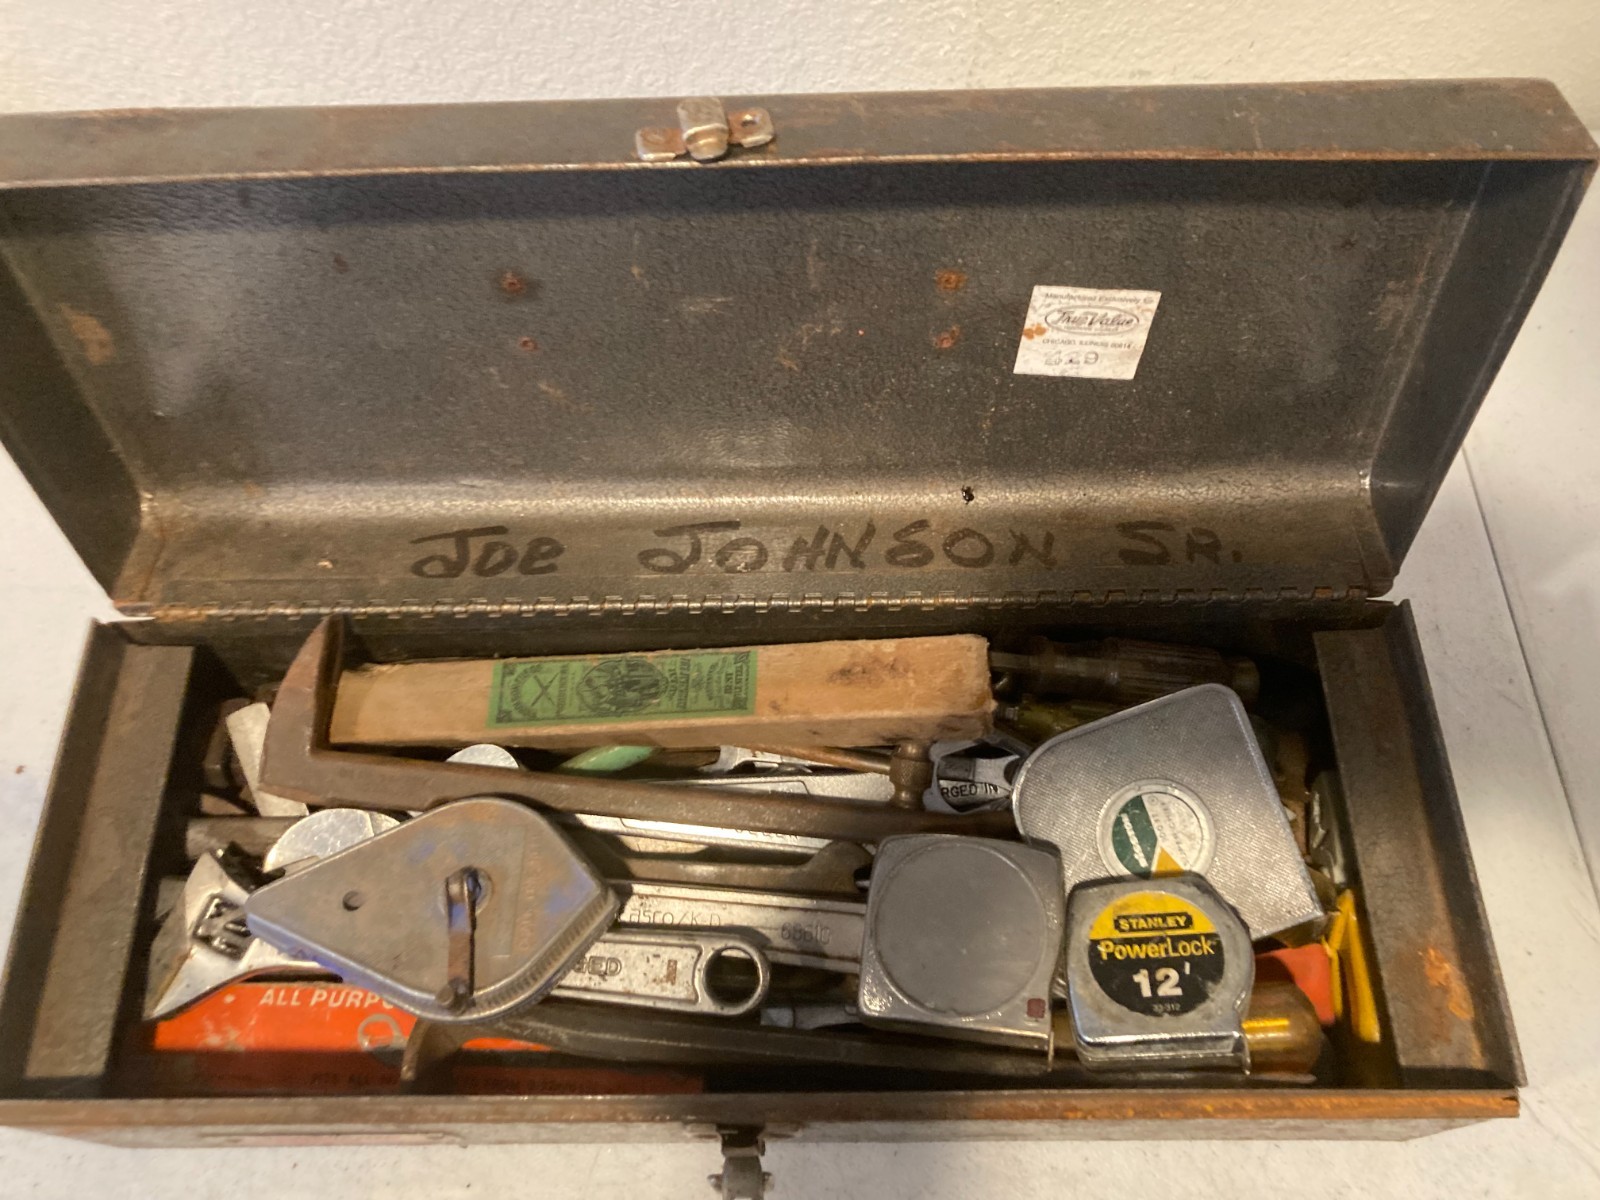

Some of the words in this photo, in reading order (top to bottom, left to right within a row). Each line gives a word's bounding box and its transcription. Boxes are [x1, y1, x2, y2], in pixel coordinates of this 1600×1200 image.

[637, 518, 1058, 574] JOHNSON
[628, 906, 722, 927] asco/K-D
[1119, 915, 1188, 931] STANLEY
[1098, 935, 1215, 961] PowerLock
[258, 988, 302, 1008] ALL
